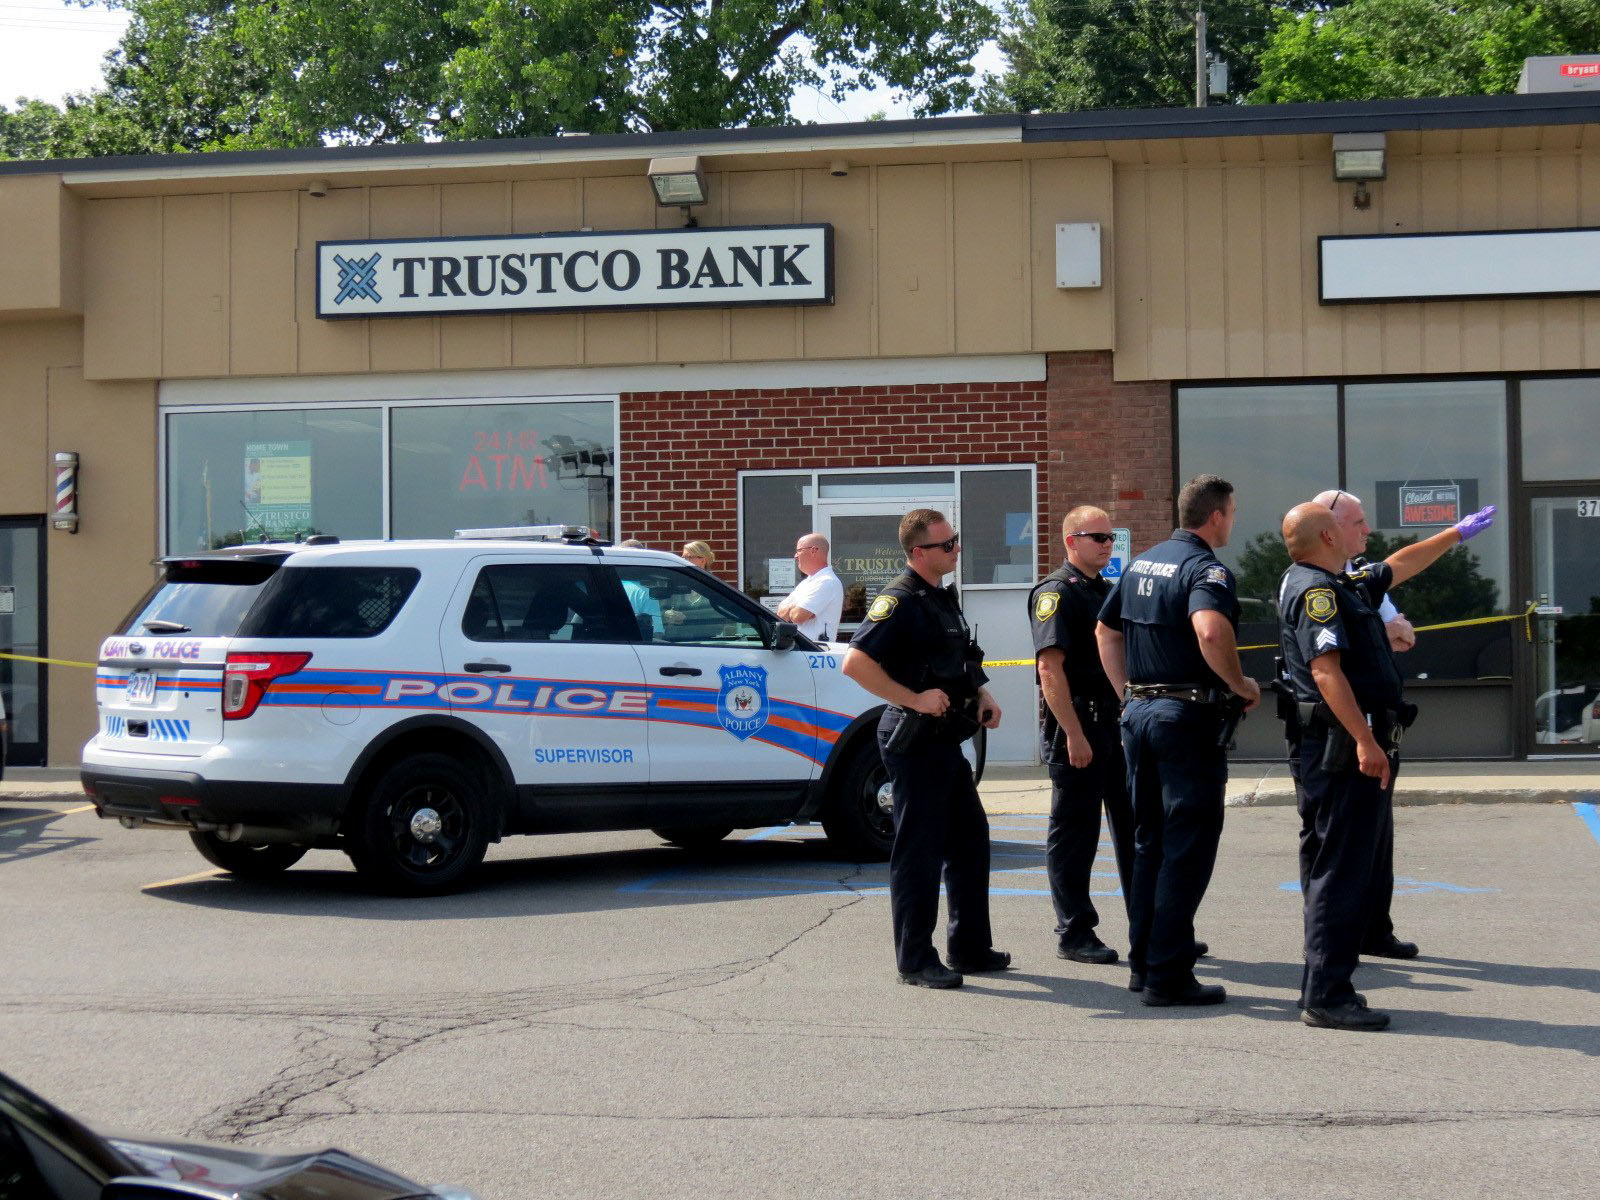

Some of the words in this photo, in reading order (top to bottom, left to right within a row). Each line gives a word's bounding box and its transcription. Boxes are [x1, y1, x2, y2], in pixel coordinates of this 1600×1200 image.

[1567, 65, 1599, 75] bryant
[392, 250, 641, 298] TRUSTCO
[656, 244, 812, 290] BANK
[268, 443, 289, 451] TOWN
[459, 453, 549, 491] ATM
[1405, 490, 1433, 504] Closed
[264, 510, 310, 520] TRUSTCO
[1404, 504, 1457, 522] AWESOME
[1579, 500, 1600, 516] 37
[265, 520, 292, 528] BANK
[844, 558, 907, 571] TRUSTC
[1130, 559, 1153, 575] STATE
[1148, 562, 1179, 578] POLICE
[1137, 577, 1154, 597] K9
[153, 641, 201, 659] POLICE
[809, 655, 837, 669] 270
[724, 669, 763, 682] ALBANY
[728, 680, 743, 688] New
[744, 678, 760, 688] York
[384, 678, 653, 714] POLICE
[725, 717, 761, 731] POLICE
[534, 748, 634, 764] SUPERVISOR
